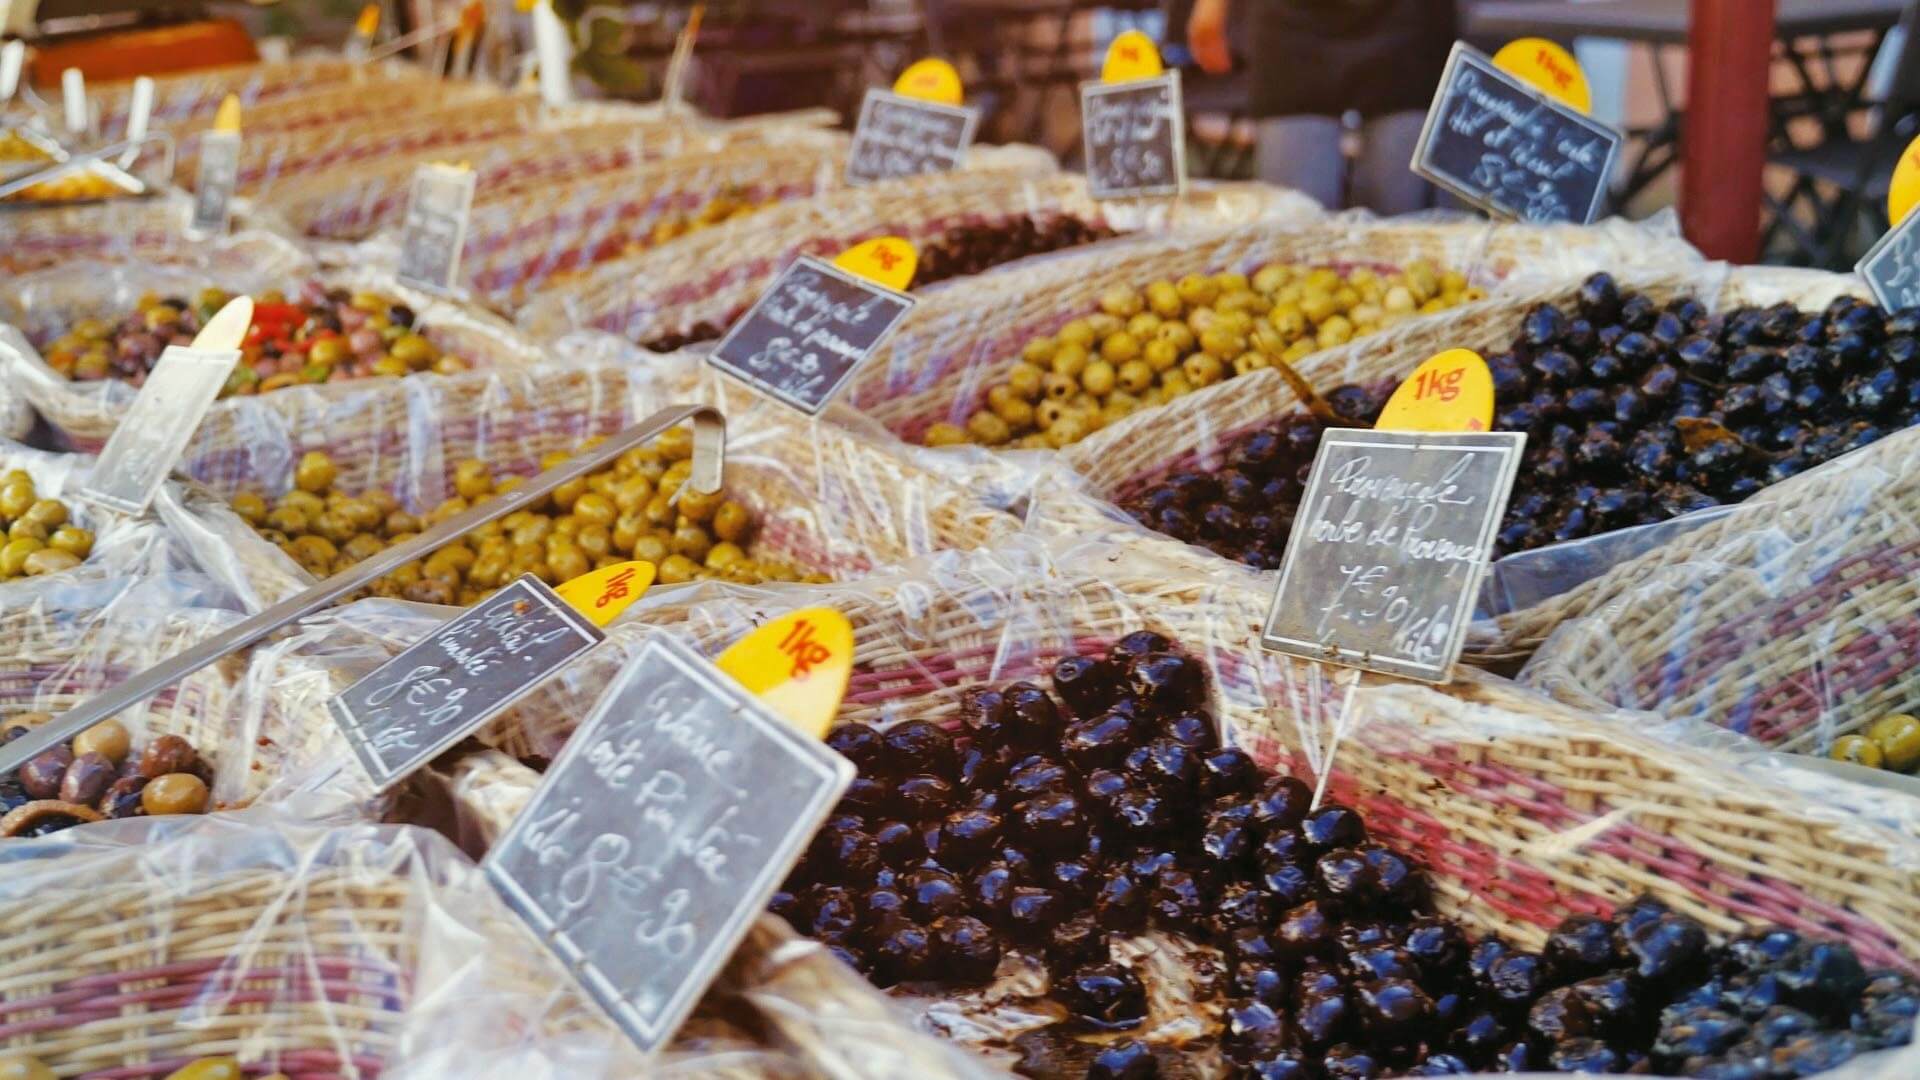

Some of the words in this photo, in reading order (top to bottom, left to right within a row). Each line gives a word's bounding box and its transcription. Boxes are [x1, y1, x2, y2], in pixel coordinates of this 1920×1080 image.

[1414, 367, 1466, 401] 1kg
[1366, 505, 1398, 546] de
[596, 568, 636, 609] 1kg
[777, 619, 832, 682] 1kg
